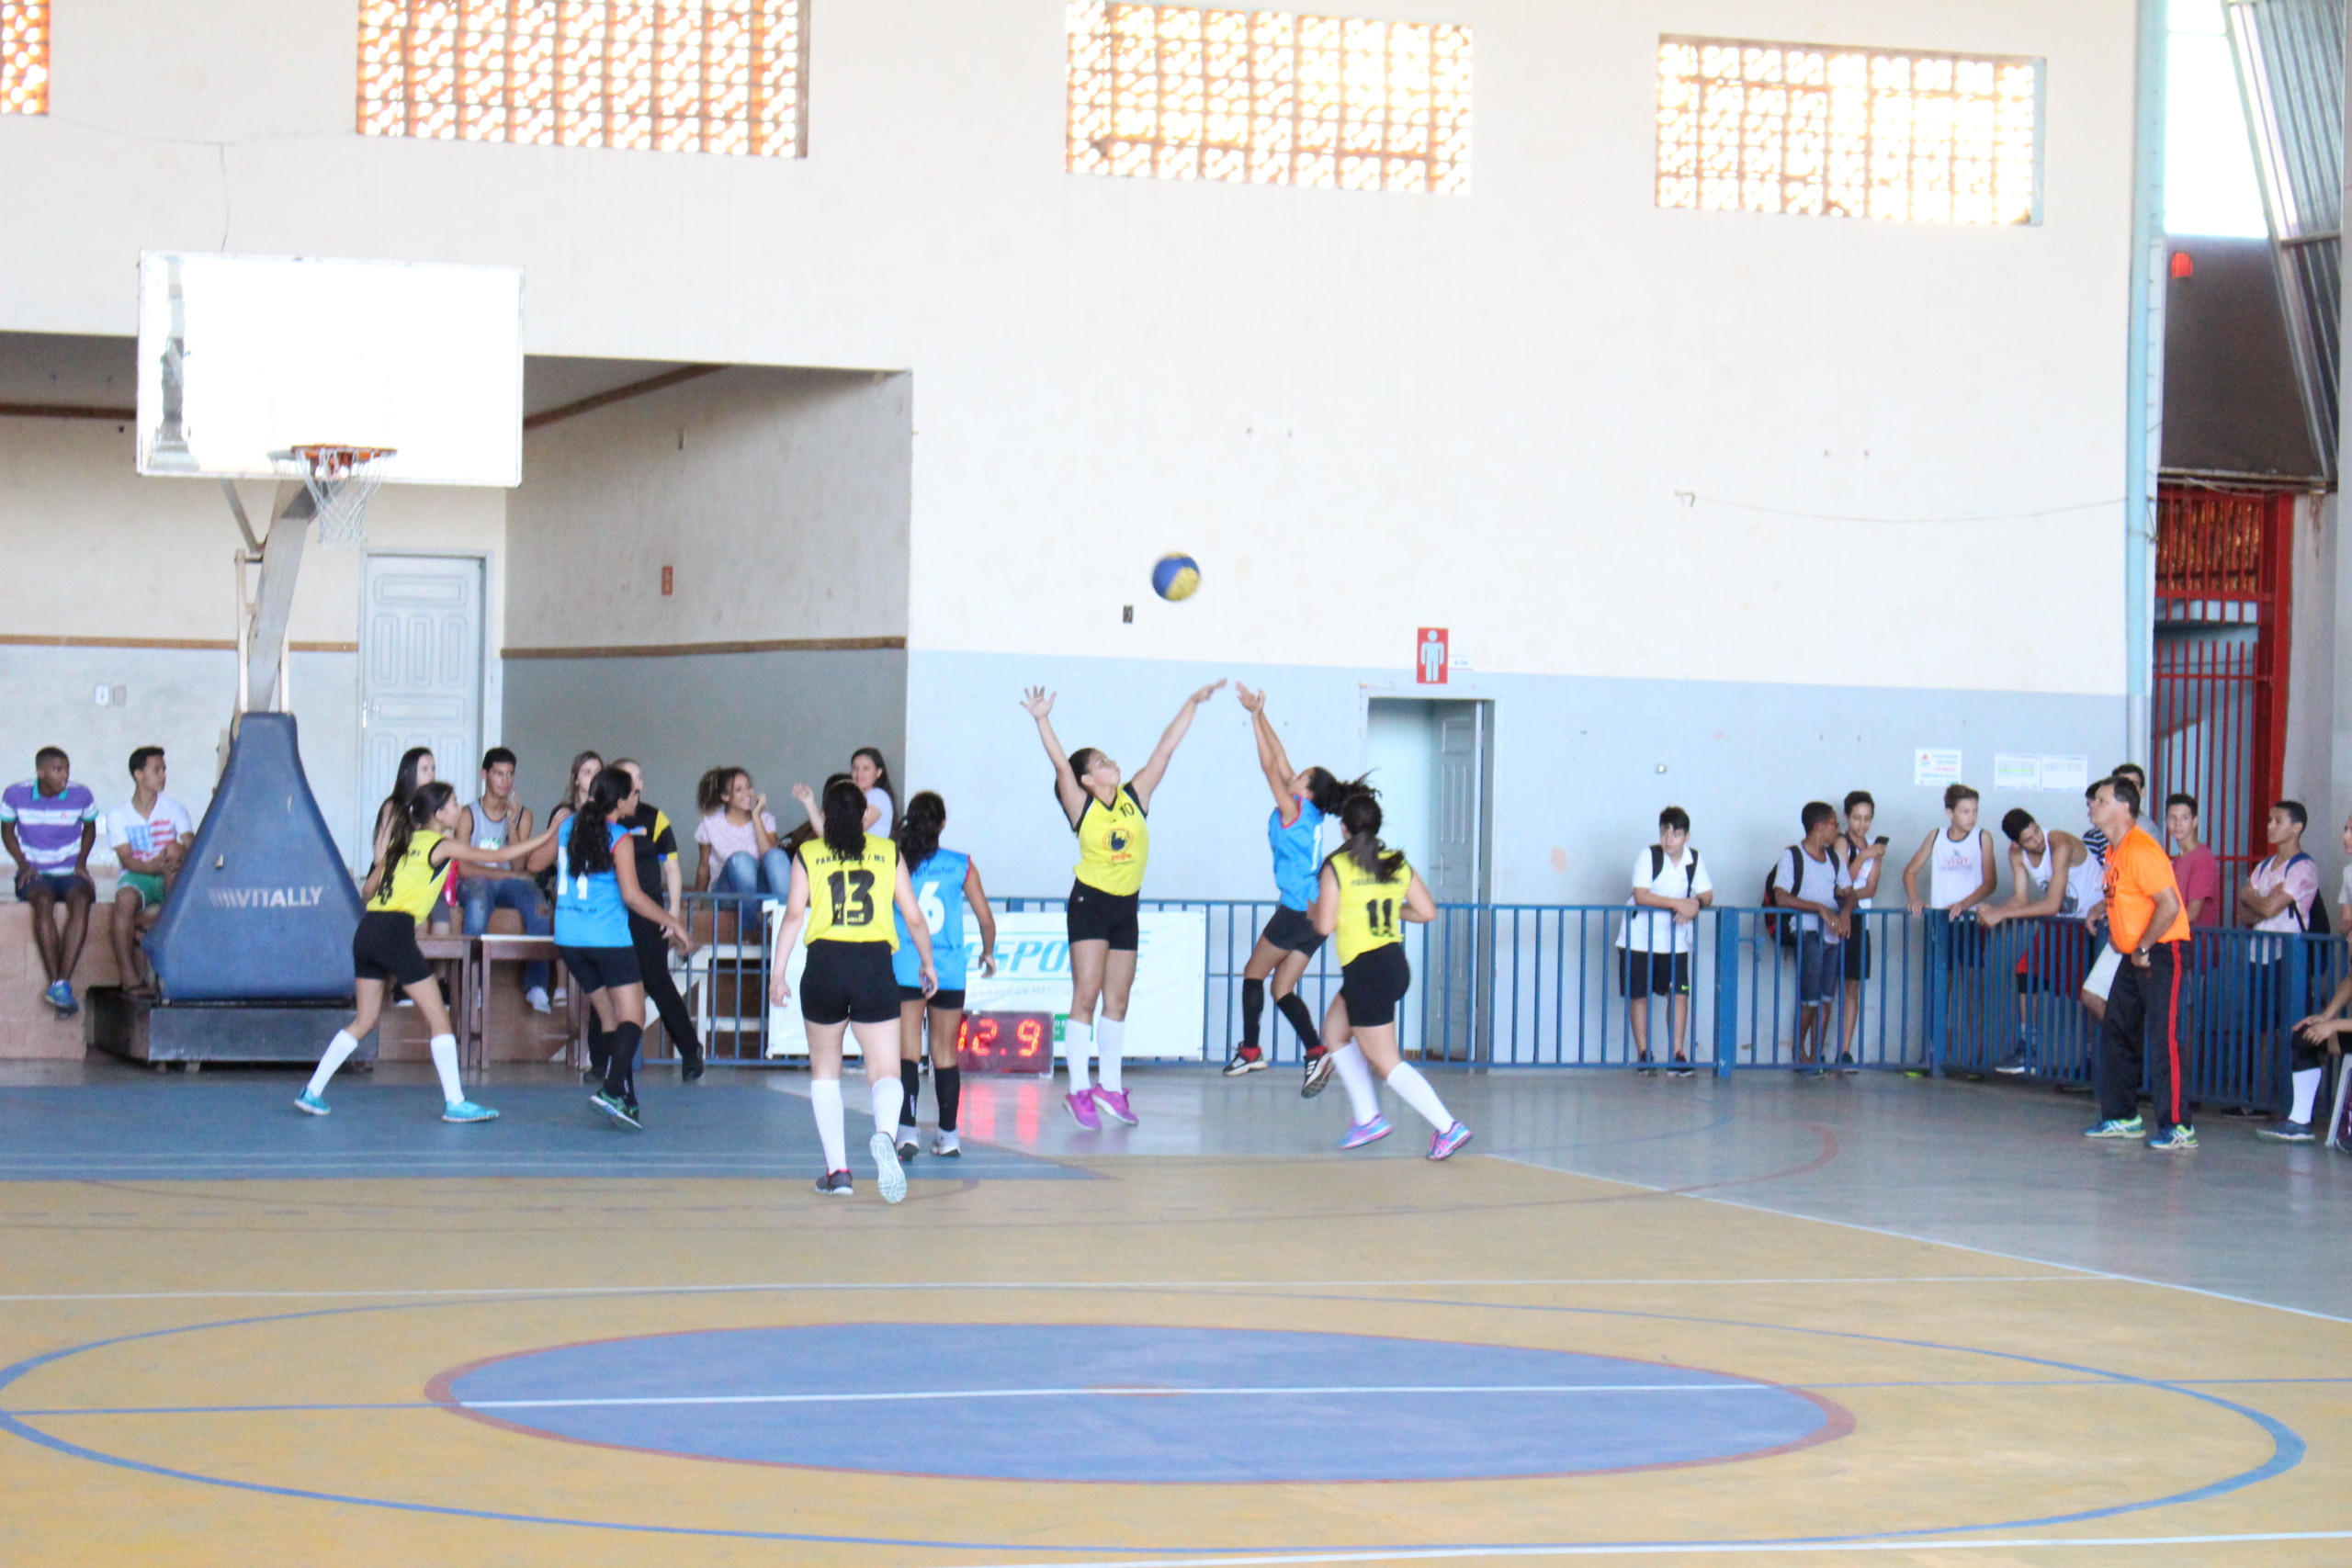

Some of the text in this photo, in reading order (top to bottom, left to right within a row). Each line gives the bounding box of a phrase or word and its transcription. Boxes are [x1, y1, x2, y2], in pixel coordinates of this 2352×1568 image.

[1119, 802, 1136, 818] 10
[235, 886, 323, 908] VITALLY
[828, 869, 875, 927] 13
[917, 881, 945, 935] 6
[1366, 897, 1394, 938] 11
[1032, 987, 1059, 996] MATO
